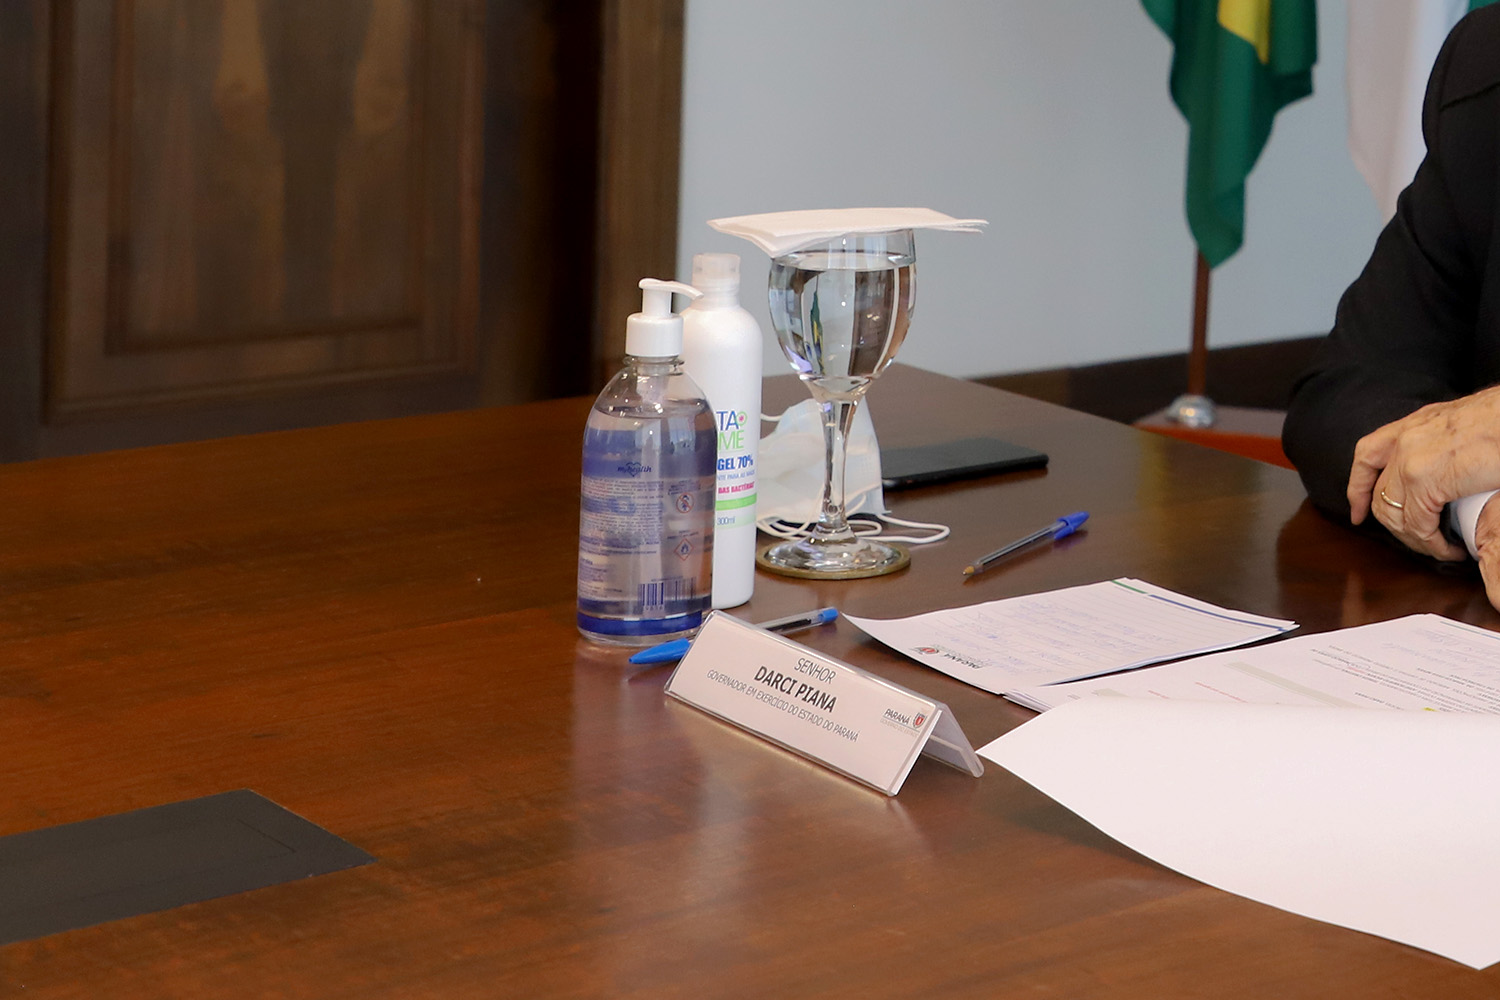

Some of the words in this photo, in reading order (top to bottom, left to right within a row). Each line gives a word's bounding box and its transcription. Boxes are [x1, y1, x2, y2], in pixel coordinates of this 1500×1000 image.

[716, 411, 740, 431] TA
[718, 430, 744, 451] ME
[717, 458, 735, 471] GEL
[737, 454, 754, 469] 70%
[794, 658, 836, 684] SENHOR
[754, 666, 798, 695] DARCI
[794, 683, 837, 713] PIANA
[706, 669, 747, 693] GOVERNADOR
[745, 686, 757, 698] EM
[755, 690, 788, 711] EXERCÍCIO
[787, 704, 798, 716] DO
[797, 708, 824, 727] ESTADO
[822, 719, 834, 732] DO
[833, 724, 860, 743] PARANÁ
[885, 707, 911, 725] PARANÁ
